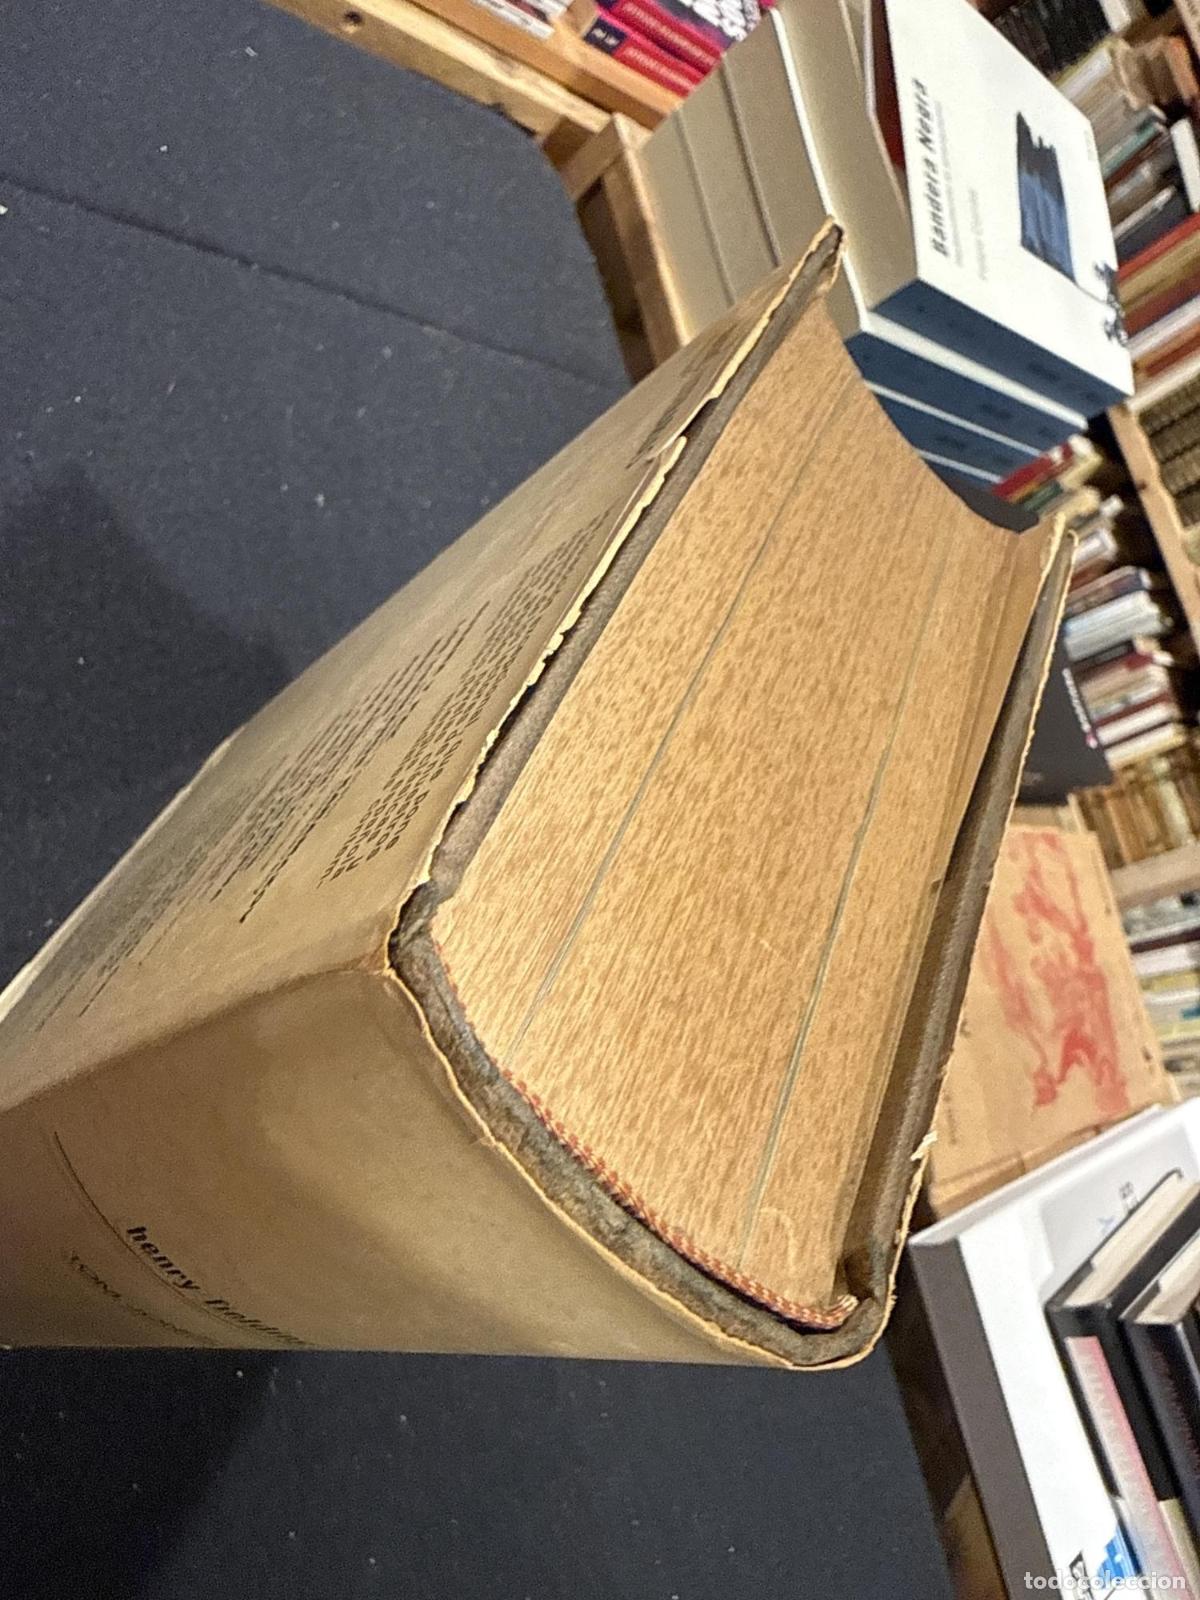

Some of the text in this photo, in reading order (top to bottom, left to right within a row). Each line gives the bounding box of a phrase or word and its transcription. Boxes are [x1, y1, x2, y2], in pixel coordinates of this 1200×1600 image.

[913, 77, 936, 155] Negra
[924, 157, 950, 258] Bandera
[436, 667, 491, 742] novelas
[457, 646, 514, 725] lectores
[405, 702, 458, 771] lengua
[429, 739, 463, 782] que
[438, 726, 461, 755] de
[331, 775, 408, 880] española
[367, 757, 440, 860] nuestros
[368, 750, 435, 842] clásicas
[384, 790, 429, 851] pone
[315, 796, 384, 890] contem-
[346, 855, 363, 872] y
[127, 1225, 200, 1291] henry
